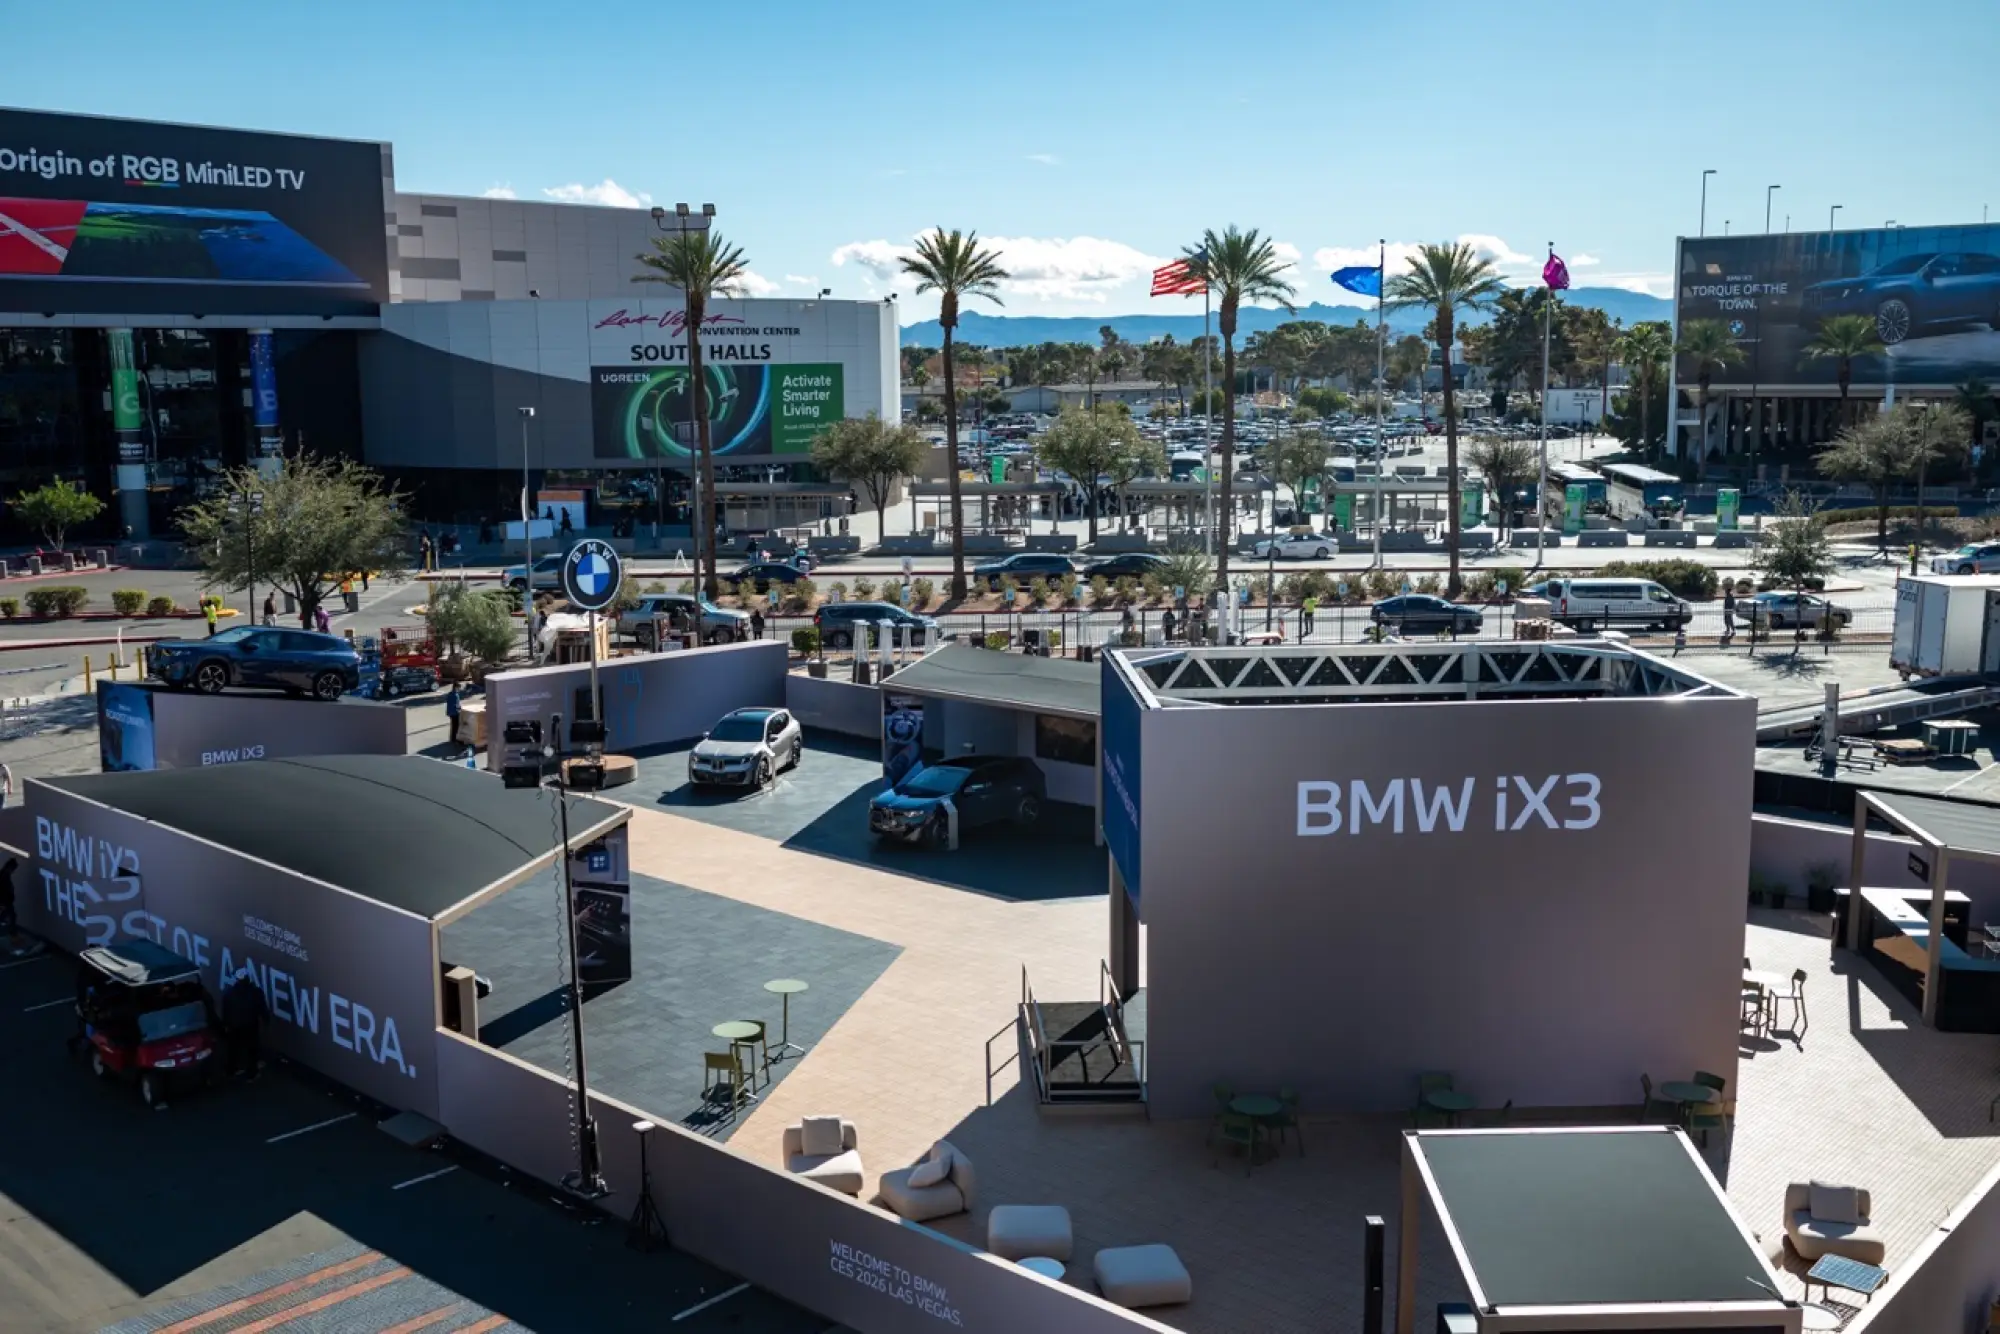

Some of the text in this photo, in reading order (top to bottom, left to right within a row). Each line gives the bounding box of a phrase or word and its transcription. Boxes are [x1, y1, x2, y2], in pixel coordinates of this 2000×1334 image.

[0, 148, 305, 190] Origin of RGB MiniLED TV
[1692, 283, 1788, 296] TORQUE OF THE
[1719, 298, 1758, 310] TOWN.
[595, 309, 745, 337] Las Vegs
[697, 327, 800, 336] ONVENTION CENTER
[631, 344, 771, 361] SOUT HALLS
[601, 373, 650, 383] UGREEN
[783, 375, 832, 387] Activate
[783, 389, 831, 401] Smarter
[783, 404, 820, 418] Living
[571, 543, 613, 564] BMW
[202, 744, 265, 765] BMW iX3
[1297, 772, 1602, 836] BMW iX3
[36, 816, 93, 877] BMW
[39, 868, 87, 927] THE
[246, 956, 320, 1034] NEW
[329, 992, 417, 1079] ERA.
[830, 1238, 949, 1302] WELCOME TO BMW.
[831, 1257, 964, 1327] CES 2026 LAS VEGAS.
